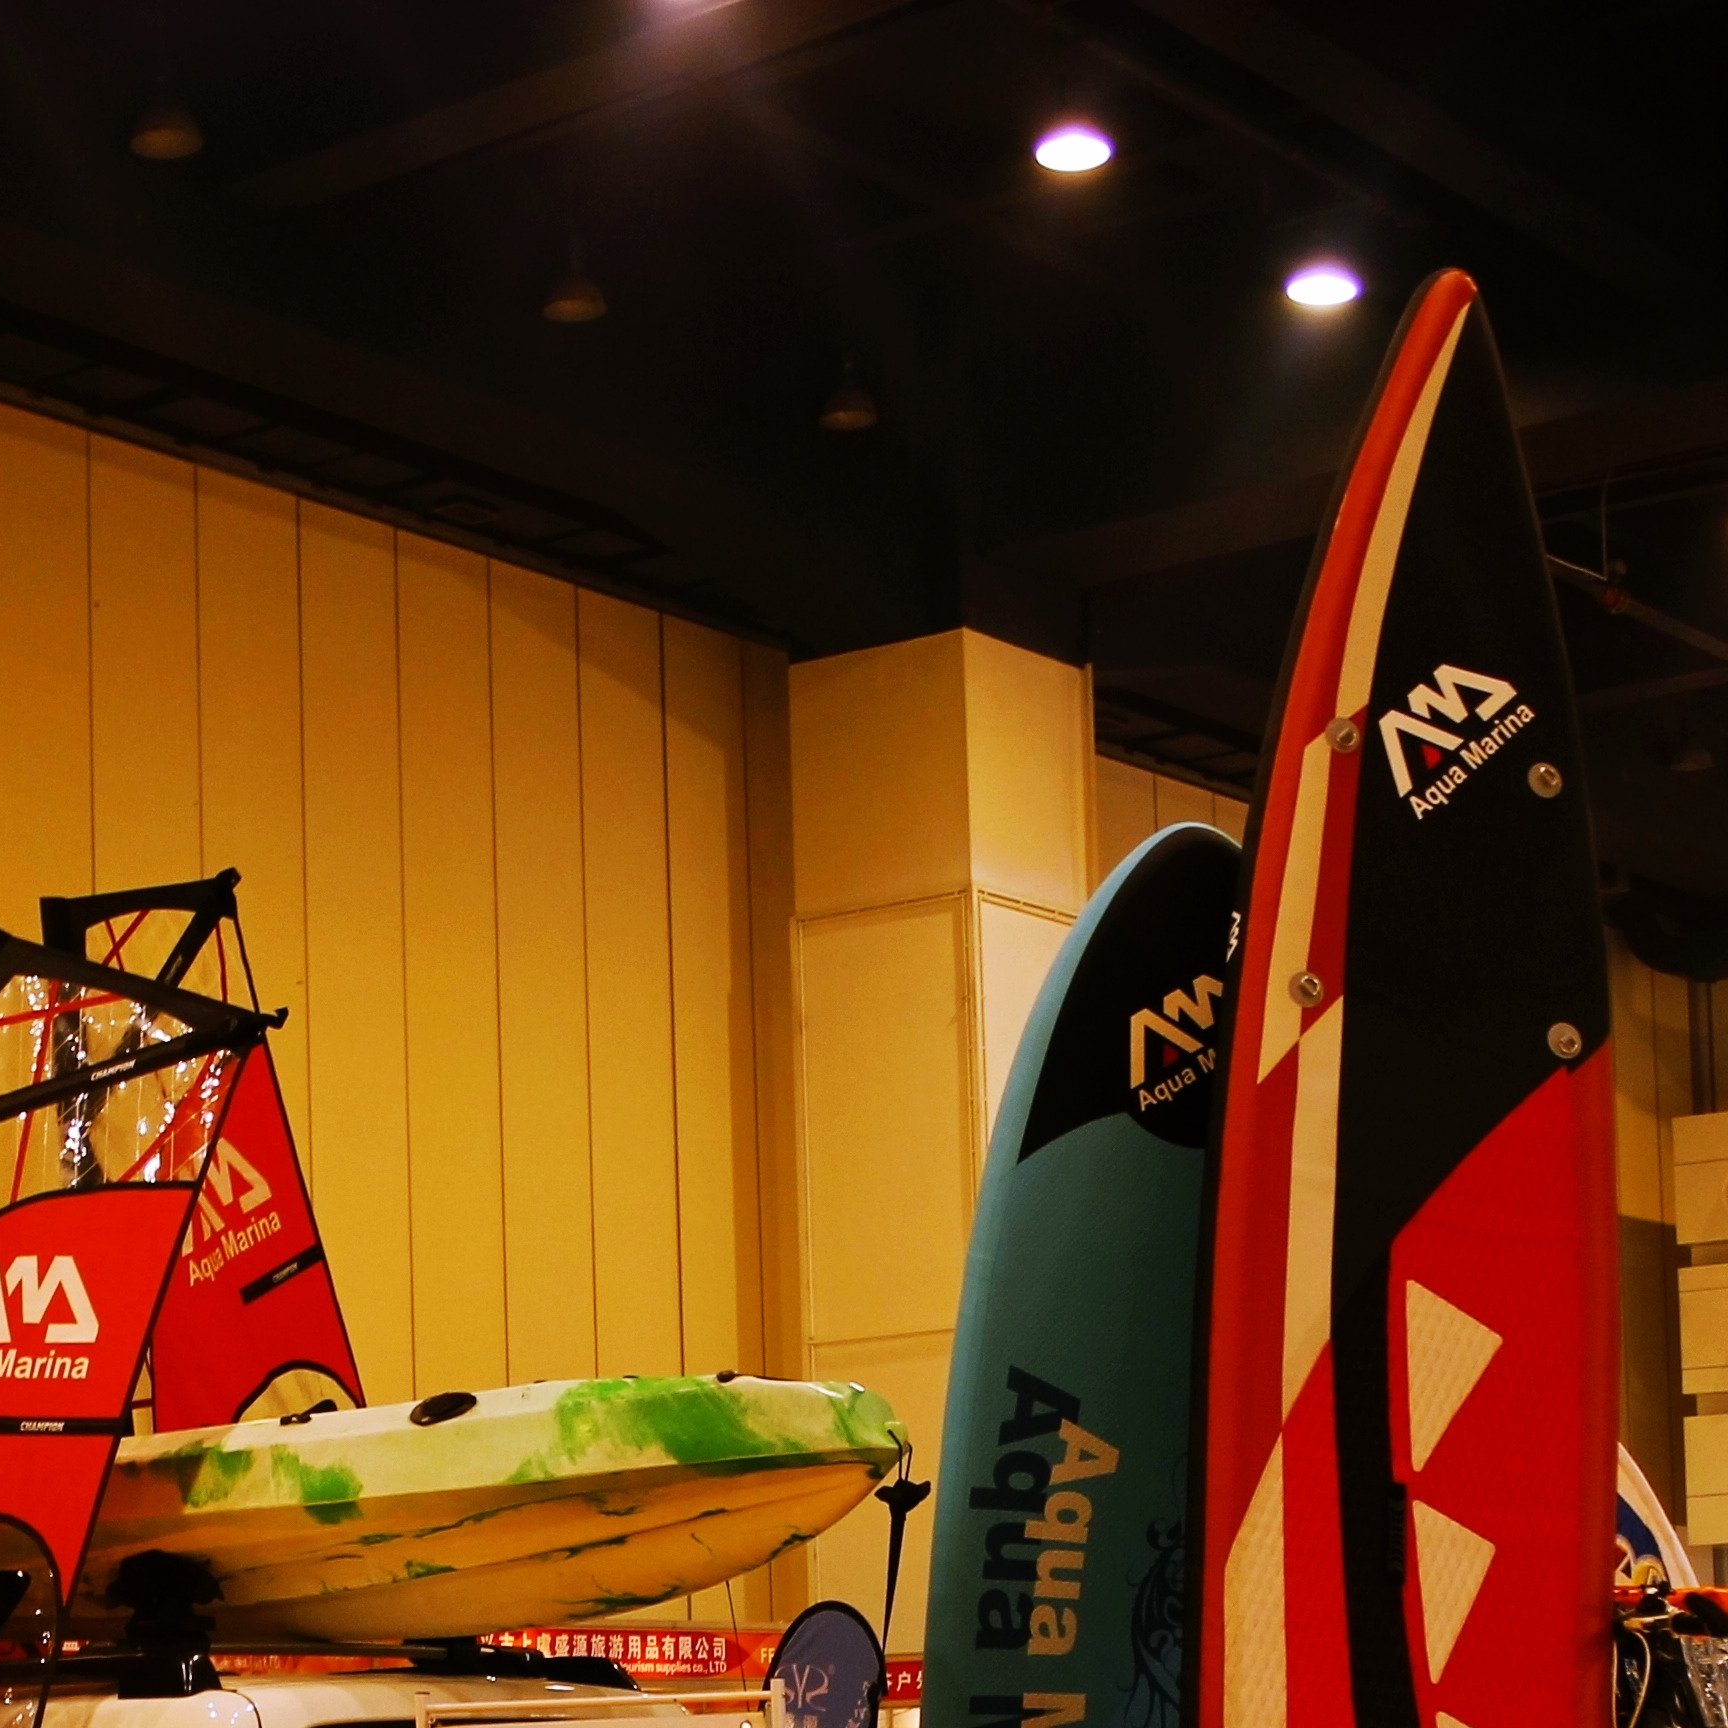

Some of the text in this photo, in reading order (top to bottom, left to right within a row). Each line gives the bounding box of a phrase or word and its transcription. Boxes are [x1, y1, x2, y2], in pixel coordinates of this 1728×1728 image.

[1408, 701, 1535, 820] Aqua Marina
[91, 1060, 136, 1081] CHAMPION
[1137, 1056, 1197, 1112] Aqua
[189, 1211, 282, 1287] Aqua Marina
[19, 1421, 64, 1433] CHAMPION
[969, 1364, 1079, 1654] Aqua
[1024, 1418, 1120, 1657] Aqua
[656, 1662, 691, 1676] supplies
[709, 1662, 727, 1673] LTD
